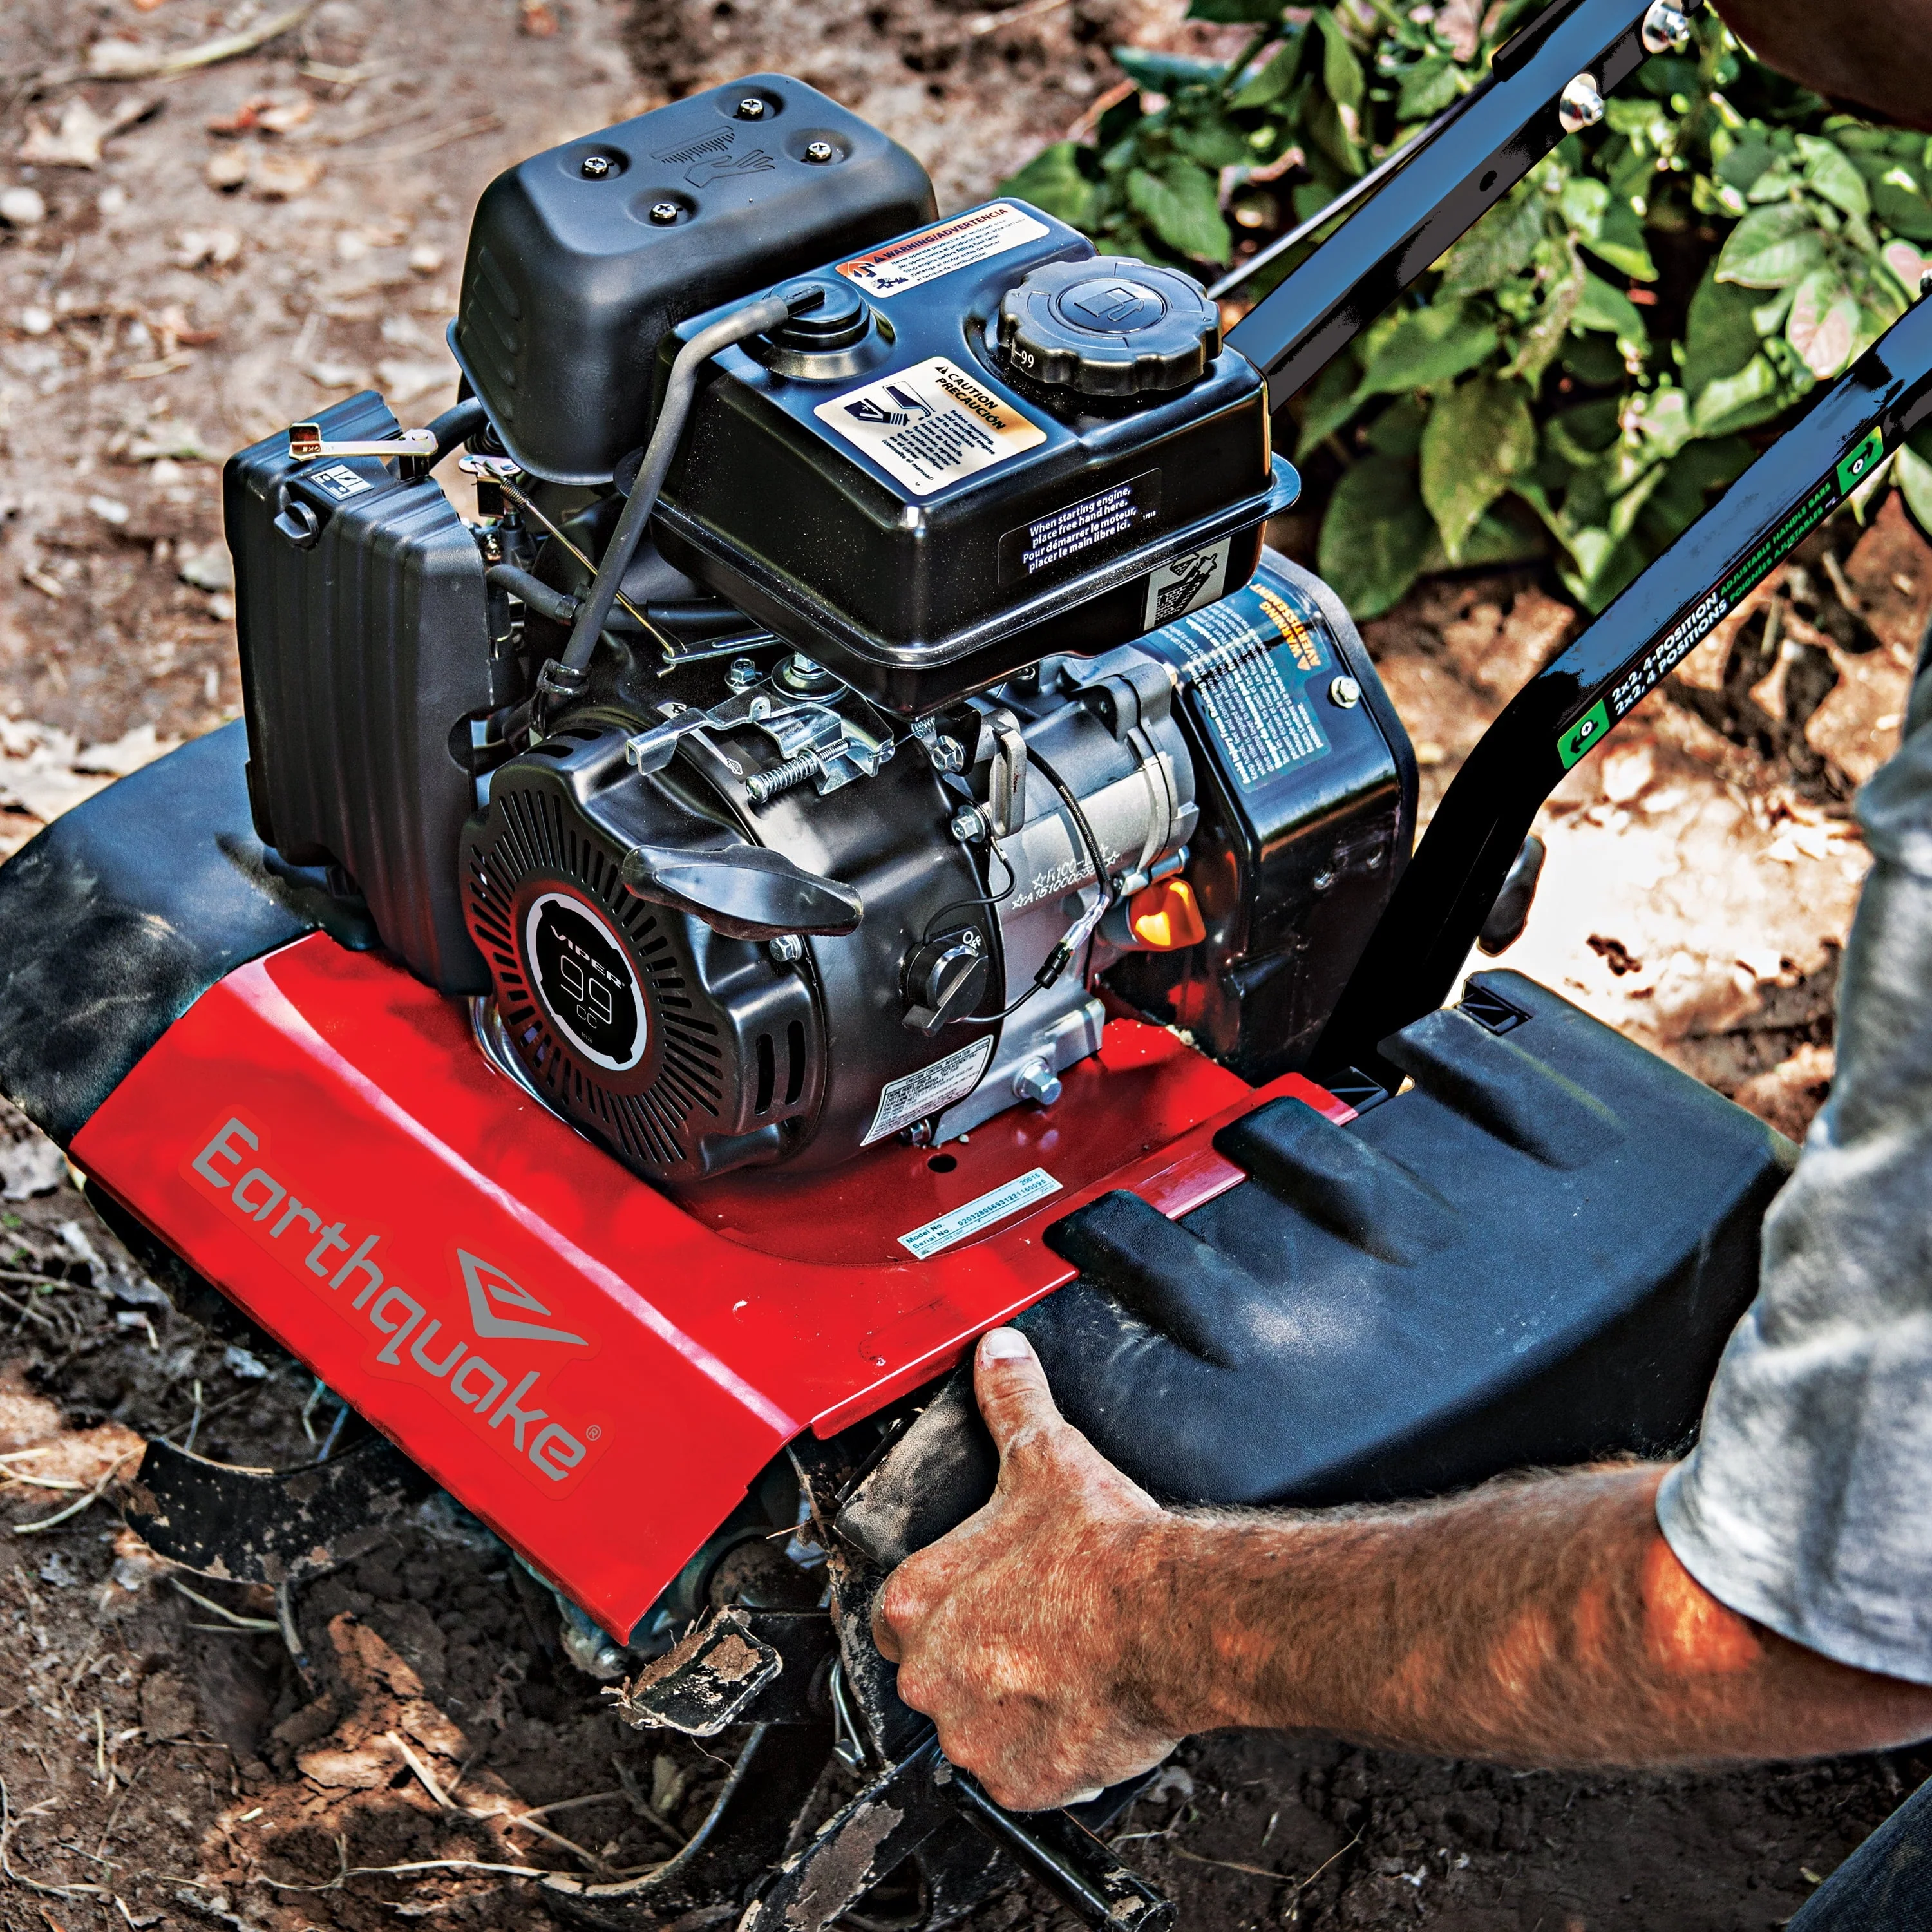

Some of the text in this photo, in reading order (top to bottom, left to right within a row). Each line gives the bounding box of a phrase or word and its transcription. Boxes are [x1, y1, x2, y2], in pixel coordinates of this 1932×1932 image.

[882, 209, 1008, 259] WARNING/ADVERTENCIA
[935, 377, 1007, 430] PRECAUCIÓN
[947, 374, 998, 410] CAUTION
[927, 420, 940, 429] (see
[949, 410, 969, 424] Before
[920, 423, 936, 435] Antes
[942, 440, 963, 457] hacerlo
[942, 413, 996, 455] add specified engine
[948, 427, 975, 448] crankcase
[896, 433, 909, 442] que
[914, 446, 944, 471] especifique
[910, 434, 927, 447] aceite
[933, 452, 951, 466] motor
[938, 447, 961, 465] agregue
[1030, 488, 1131, 536] When starting engine,
[1032, 500, 1128, 549] place free hand here.
[1023, 507, 1137, 564] Pour démarrer le moteur,
[1029, 518, 1131, 573] placer le main libre ici.
[1611, 482, 1831, 703] 2x2, 4-POSITION ADJUSTABLE HANDLE BARS
[1615, 506, 1823, 715] 2x2, 4 POSITIONS POIGNÉES AJUSTABLES
[1249, 583, 1321, 666] AVERTISSEMENT
[1259, 601, 1302, 658] WARNING
[1209, 665, 1220, 681] drive
[1224, 674, 1236, 690] stops
[1217, 681, 1229, 698] when
[1231, 691, 1245, 712] neutral
[1213, 694, 1229, 719] clothing
[1226, 698, 1235, 711] and
[1196, 682, 1251, 784] Avoid Injury From Rotating
[1224, 719, 1235, 731] and
[1231, 710, 1249, 737] engaged
[1245, 720, 1256, 735] lever
[1230, 731, 1240, 743] feet
[1247, 743, 1258, 757] tiller
[1253, 735, 1267, 755] control
[1246, 763, 1259, 779] Keep
[1253, 757, 1266, 775] when
[1262, 755, 1274, 771] drive
[550, 925, 622, 989] VIPER
[561, 955, 612, 1024] 99
[905, 1229, 931, 1244] Model
[912, 1235, 936, 1249] Serial
[192, 1117, 587, 1481] Earthquake
